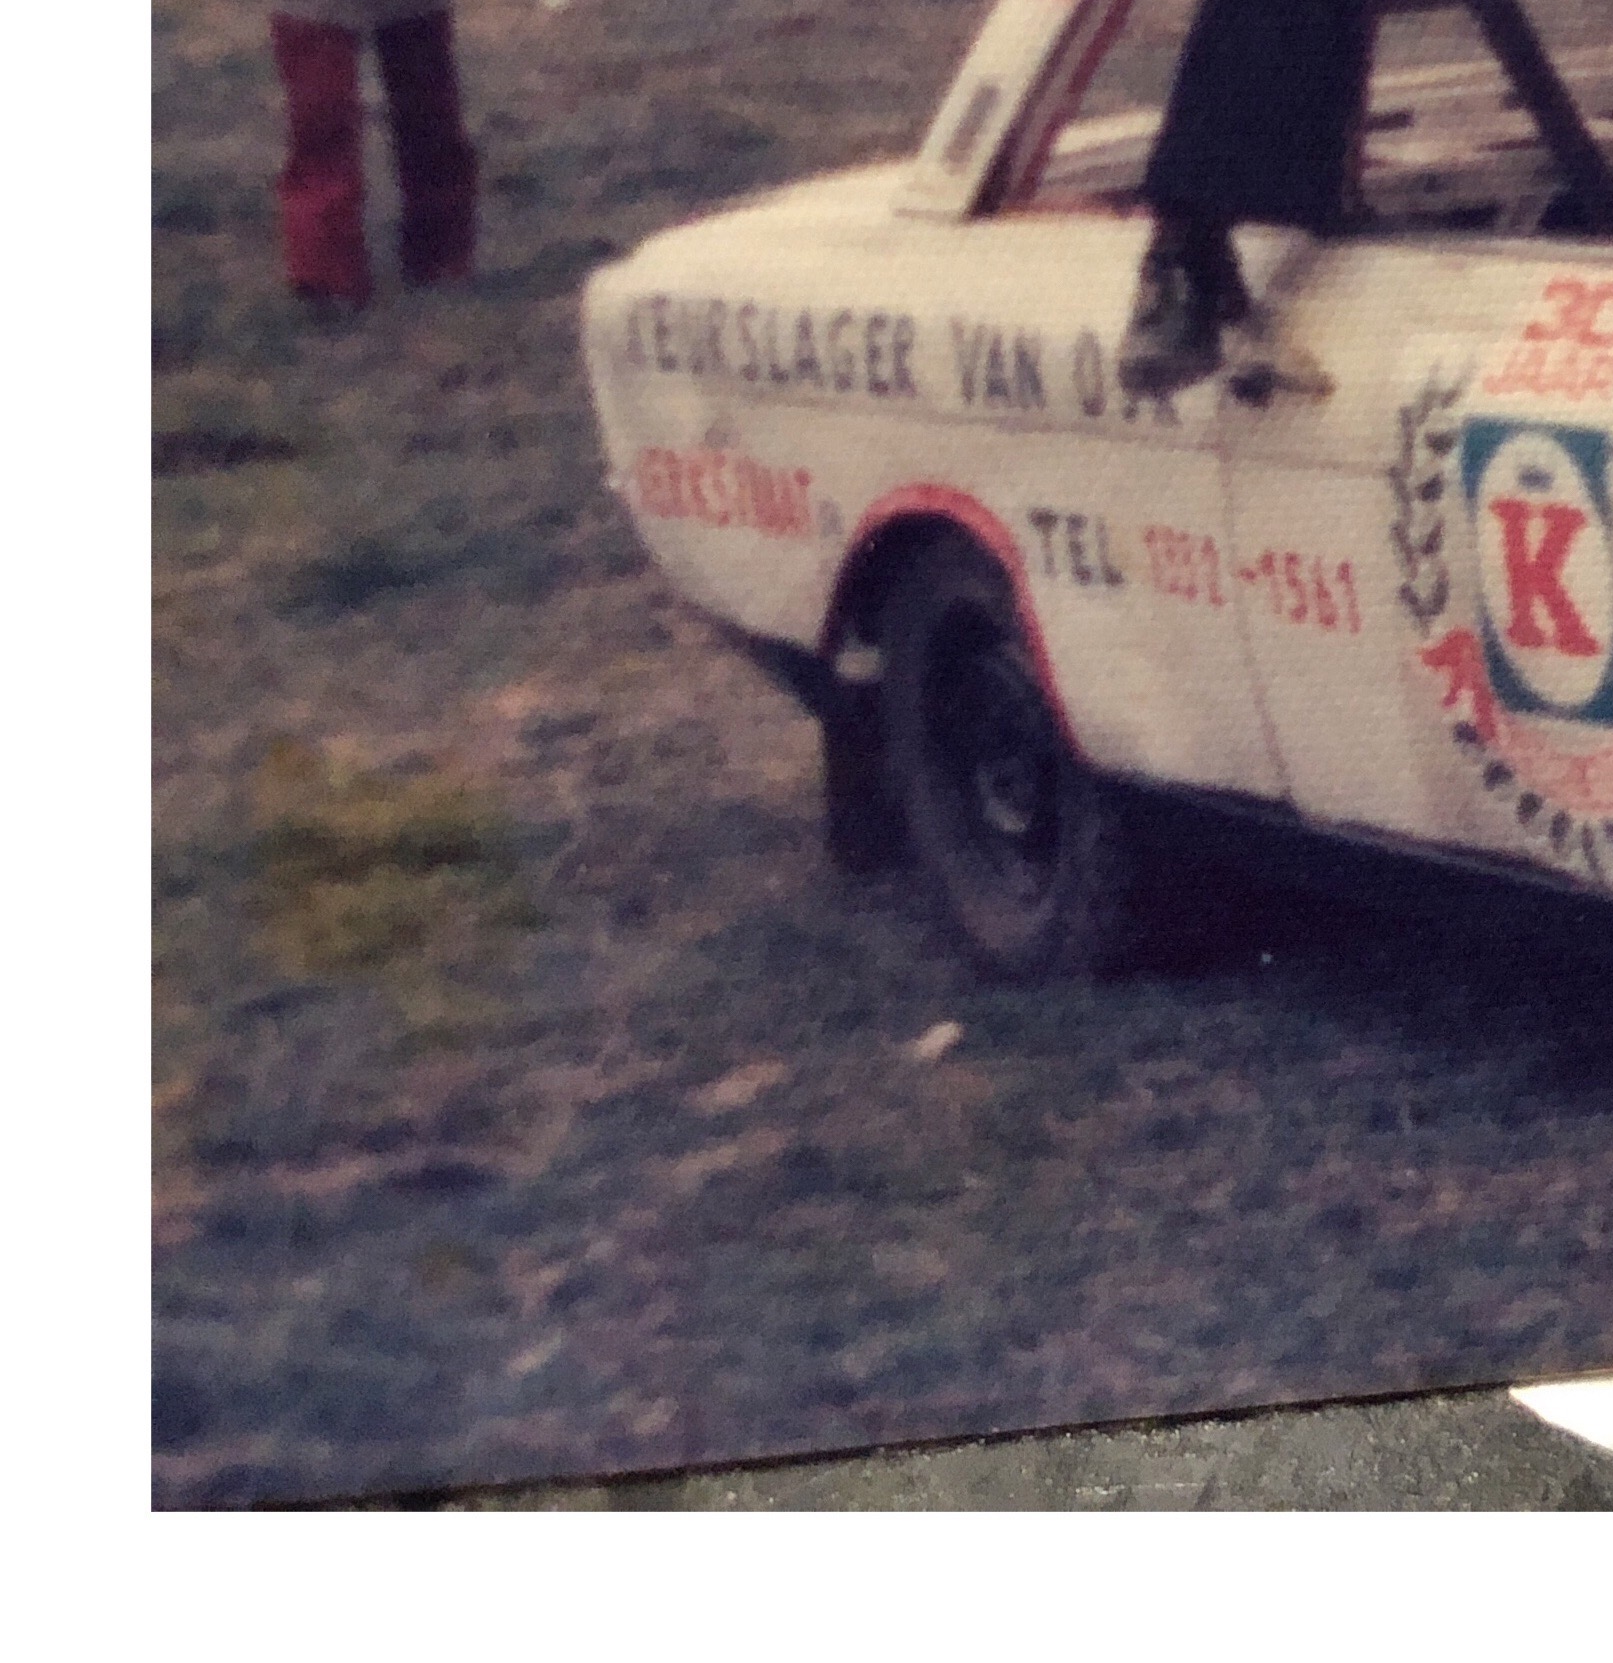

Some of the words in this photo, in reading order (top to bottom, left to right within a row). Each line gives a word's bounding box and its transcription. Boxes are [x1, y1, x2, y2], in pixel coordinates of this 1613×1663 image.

[948, 311, 1046, 411] VAN
[1027, 504, 1126, 588] TEL
[1488, 496, 1602, 658] K
